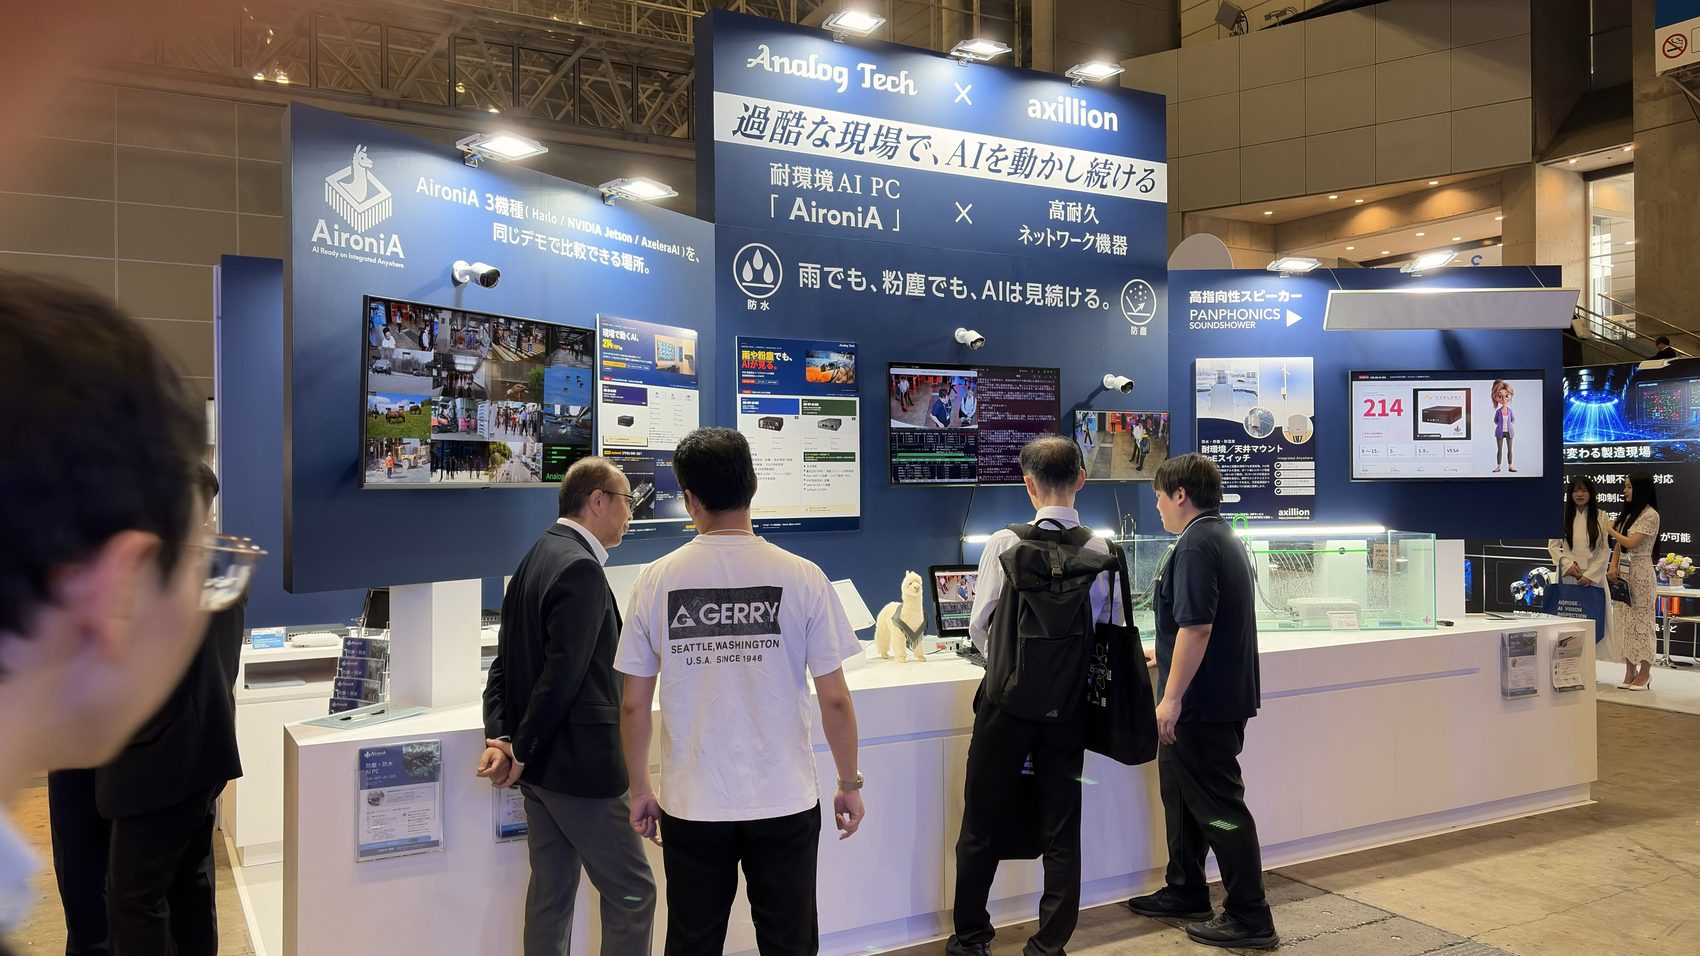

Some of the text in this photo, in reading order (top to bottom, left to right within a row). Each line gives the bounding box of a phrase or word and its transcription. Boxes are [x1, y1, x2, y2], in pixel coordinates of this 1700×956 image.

[746, 44, 849, 93] Analog
[857, 62, 918, 96] Tech
[1027, 95, 1119, 132] axillion
[732, 102, 1157, 194] 過酷な現場で、AIを動かし続ける
[870, 176, 900, 199] PC
[416, 176, 480, 208] AironiA
[532, 208, 557, 224] Hailo
[567, 217, 603, 236] NVIDIA
[604, 226, 633, 244] Jetson
[641, 236, 680, 256] AxeleraAI
[1048, 199, 1100, 225] 高耐久
[311, 218, 405, 259] AironiA
[493, 222, 650, 274] 同じデモで比較できる場所。
[1017, 224, 1128, 256] ネットワーク機器
[320, 247, 339, 258] Ready
[348, 253, 377, 263] Integrated
[378, 258, 405, 268] Anywhere
[798, 262, 1110, 311] 雨でも、粉塵でも、AIは見続ける。
[1189, 289, 1303, 304] 高指向性スピーカー
[747, 299, 770, 311] 防水
[1189, 308, 1281, 321] PANPHONICS
[1189, 321, 1256, 329] SOUNDSHOWER
[741, 361, 778, 371] AIが見る。
[1363, 398, 1404, 417] 214
[1278, 508, 1310, 517] axillion
[699, 601, 779, 626] GERRY
[686, 654, 763, 666] U.S.A. SINCE 1946
